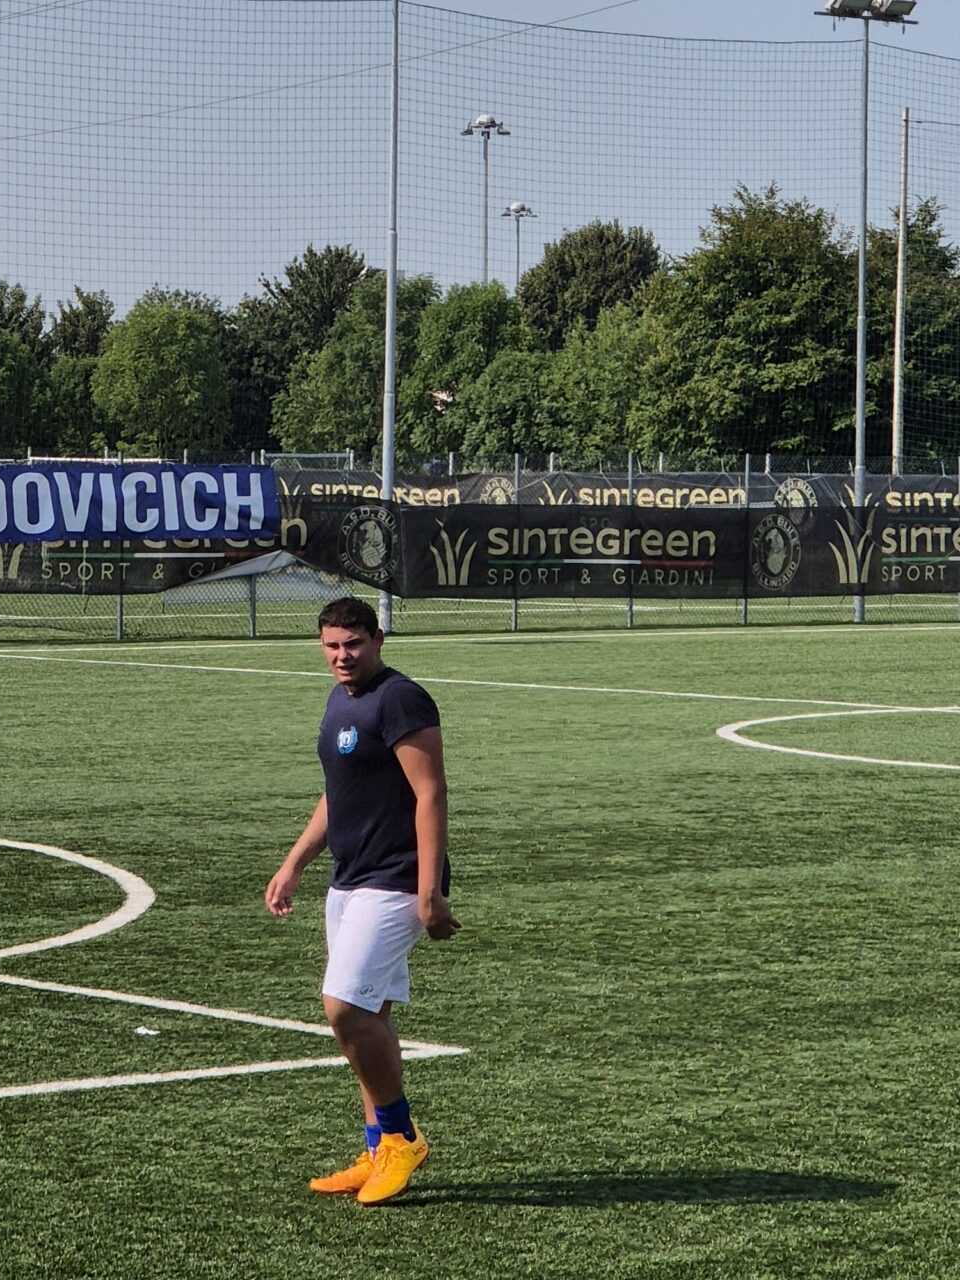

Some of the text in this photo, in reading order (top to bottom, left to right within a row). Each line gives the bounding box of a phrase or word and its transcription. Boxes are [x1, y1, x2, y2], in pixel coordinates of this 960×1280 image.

[41, 562, 132, 581] SPORT
[152, 563, 166, 580] &
[487, 567, 714, 586] SPORT & GIARDINI
[881, 564, 947, 582] SPORT
